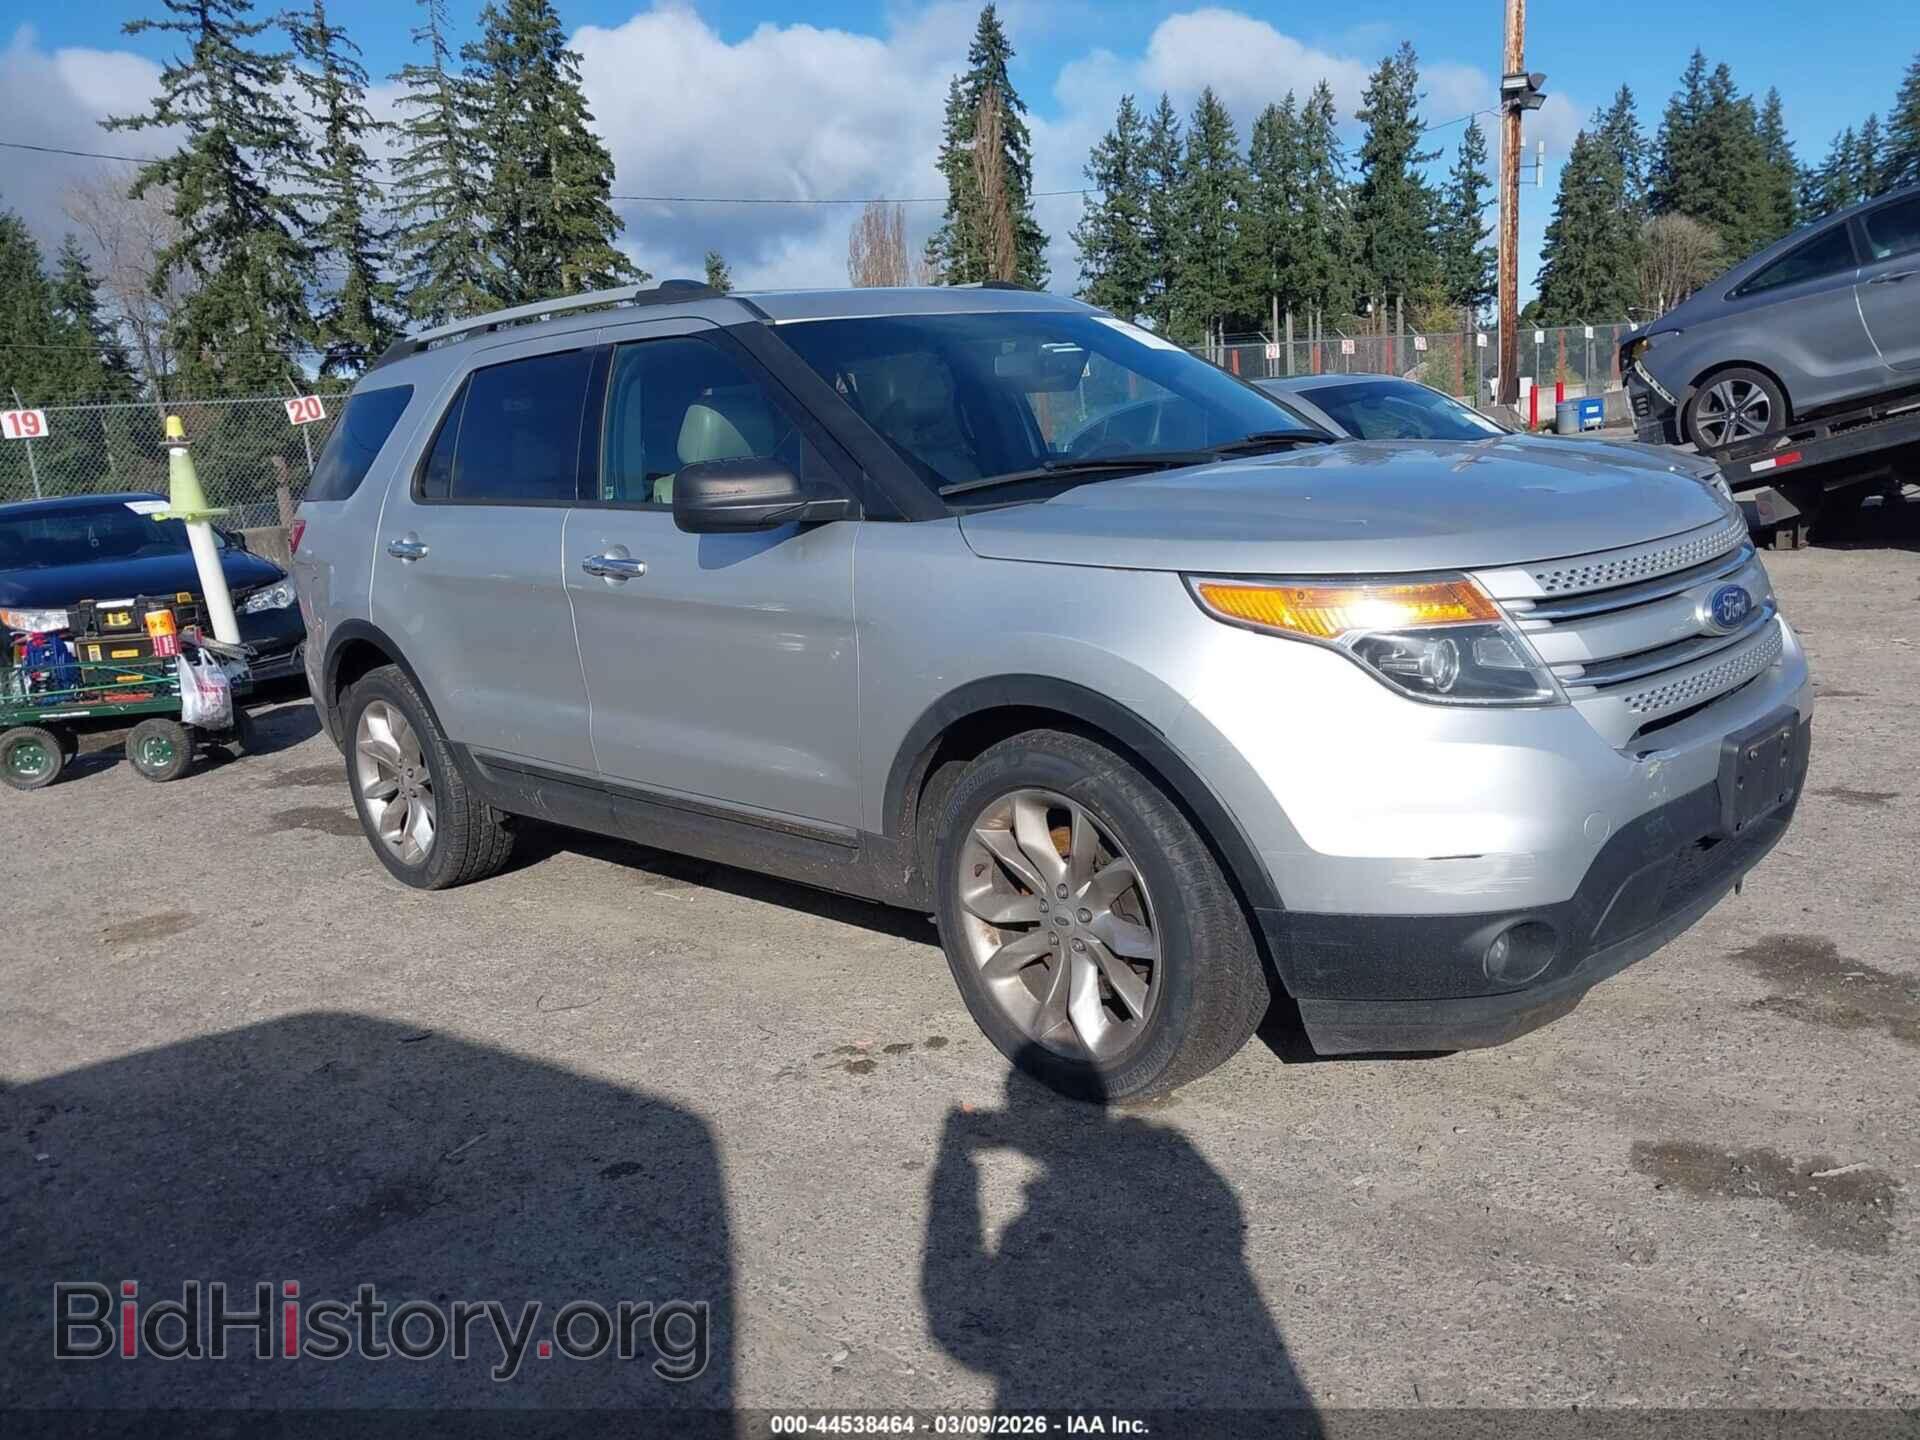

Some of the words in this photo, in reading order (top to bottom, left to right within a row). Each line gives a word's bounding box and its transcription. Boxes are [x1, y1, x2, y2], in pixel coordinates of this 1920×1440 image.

[290, 398, 320, 423] 20
[8, 412, 40, 436] 19
[1721, 591, 1747, 620] Ford
